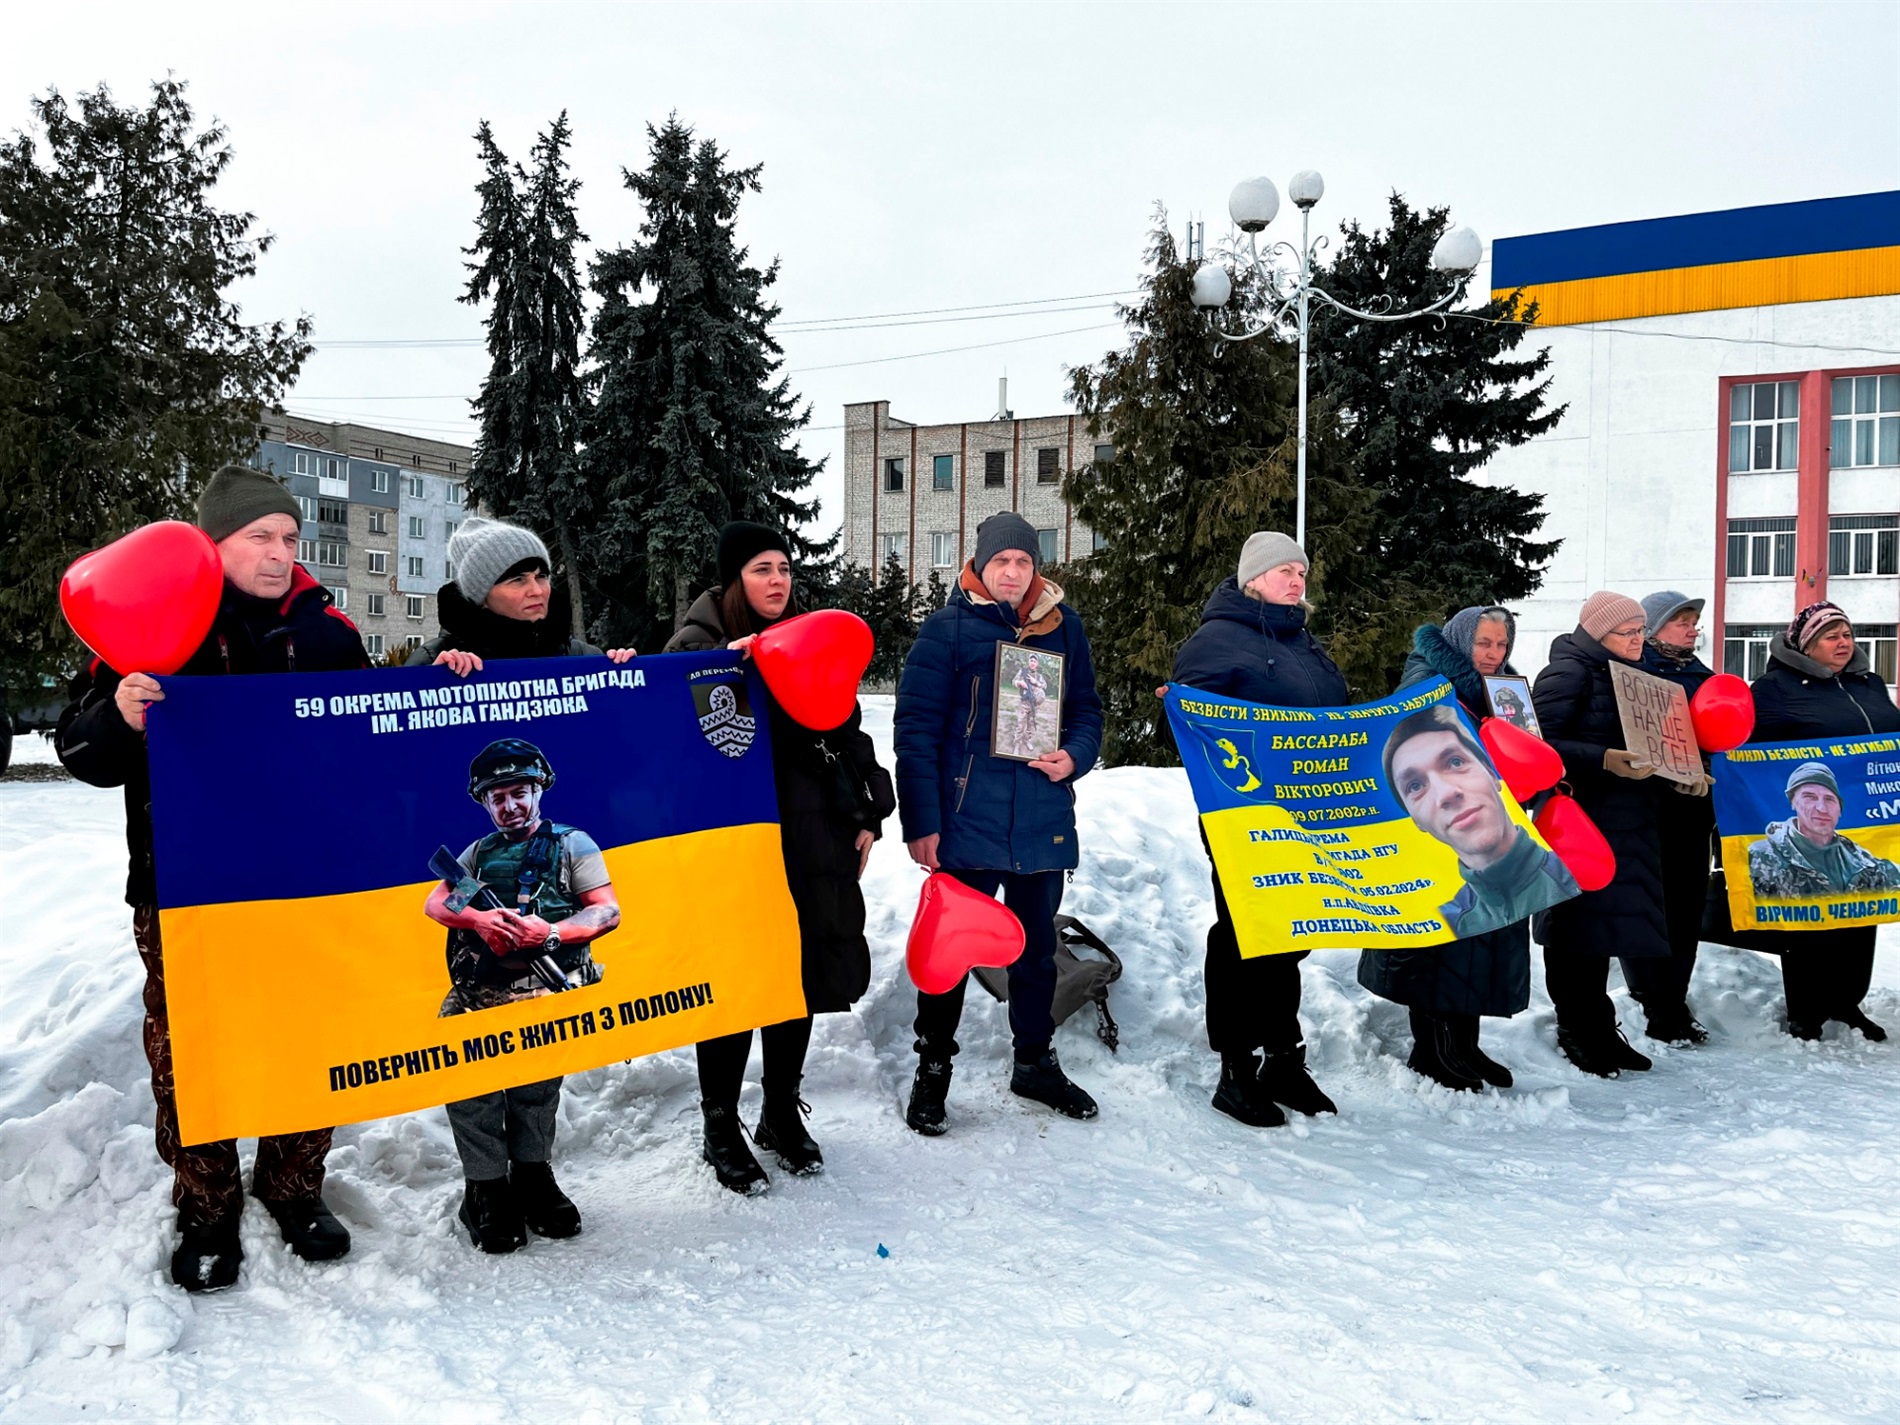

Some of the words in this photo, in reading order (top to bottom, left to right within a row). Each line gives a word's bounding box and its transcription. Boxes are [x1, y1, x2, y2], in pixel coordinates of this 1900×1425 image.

[295, 698, 325, 717] 59
[330, 691, 416, 715] ОКРЕМА
[419, 678, 558, 709] МОТОПІХОТНА
[563, 670, 646, 694] БРИГАДА
[372, 713, 403, 734] ІМ.
[408, 704, 475, 730] ЯКОВА
[478, 695, 588, 722] ГАНДЗЮКА
[1180, 699, 1248, 720] БЕЗВІСТИ
[1323, 711, 1345, 720] НЕ
[1344, 704, 1400, 719] ЗНАЧИТЬ
[1631, 705, 1686, 743] НАШЕ
[1271, 731, 1369, 750] БАССАРАБА
[1766, 746, 1824, 761] БЕЗВІСТИ
[1829, 745, 1847, 756] НЕ
[1846, 740, 1896, 755] ЗАГИБЛІ
[1292, 757, 1349, 775] РОМАН
[1646, 735, 1692, 776] ВСЕ!
[1274, 778, 1378, 800] ВІКТОРОВИЧ
[1373, 844, 1398, 858] НГУ
[1252, 873, 1304, 888] ЗНИК
[1756, 905, 1825, 922] ВІРИМО,
[1292, 919, 1381, 937] ДОНЕЦЬКА
[1381, 920, 1442, 934] ОБЛАСТЬ
[329, 1044, 458, 1091] ПОВЕРНІТЬ
[462, 1031, 516, 1063] МОЄ
[519, 1011, 596, 1050] ЖИТТЯ
[600, 1006, 615, 1030] З
[619, 982, 714, 1026] ПОЛОНУ!
